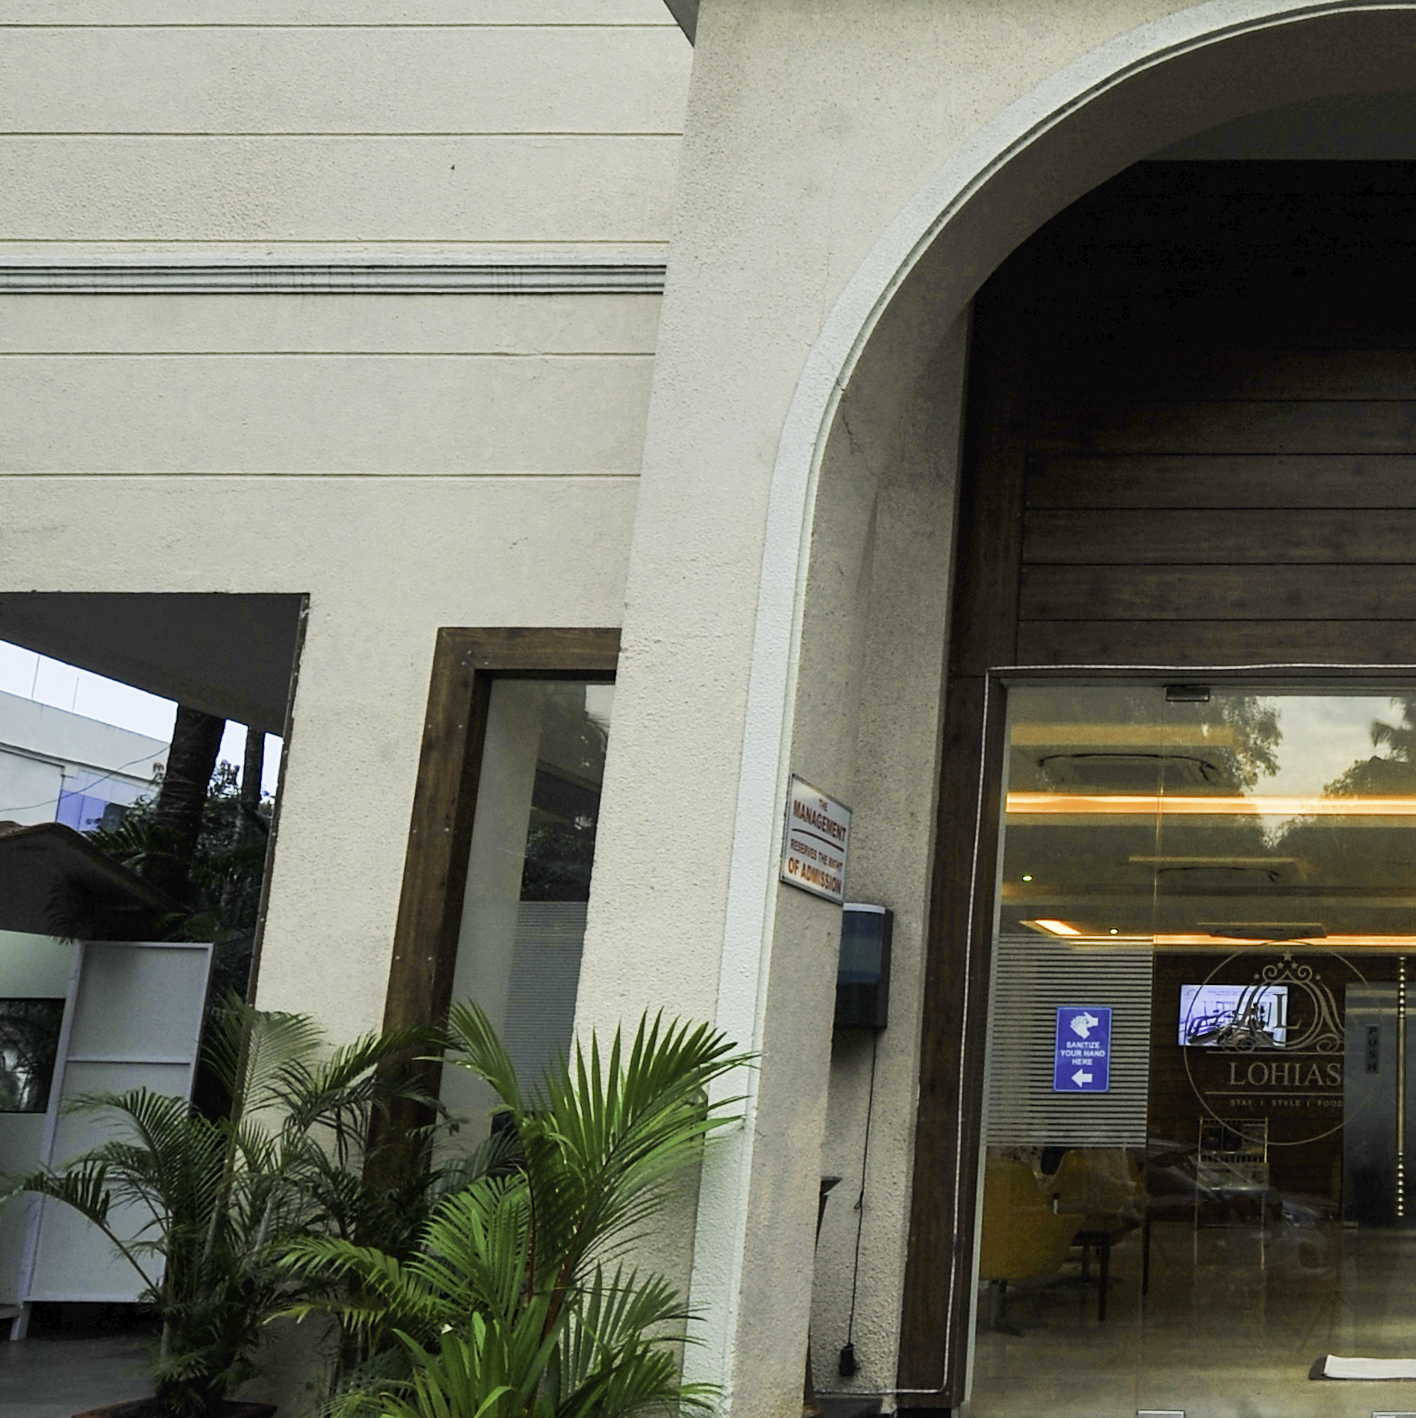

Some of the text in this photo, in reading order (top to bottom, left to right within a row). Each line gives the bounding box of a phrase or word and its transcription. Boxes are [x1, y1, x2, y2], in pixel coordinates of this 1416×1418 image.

[818, 798, 828, 812] THE
[793, 799, 846, 842] MANAGEMENT
[790, 838, 817, 860] RESERVES
[818, 851, 828, 865] THE
[788, 856, 842, 894] OF ADMISSION
[1066, 1041, 1100, 1049] SANITIZE
[1060, 1049, 1106, 1057] YOUR HAND
[1071, 1058, 1093, 1066] HERE
[1229, 1062, 1342, 1087] LOHIAS
[1230, 1099, 1344, 1108] STAY STYLE FOOD
